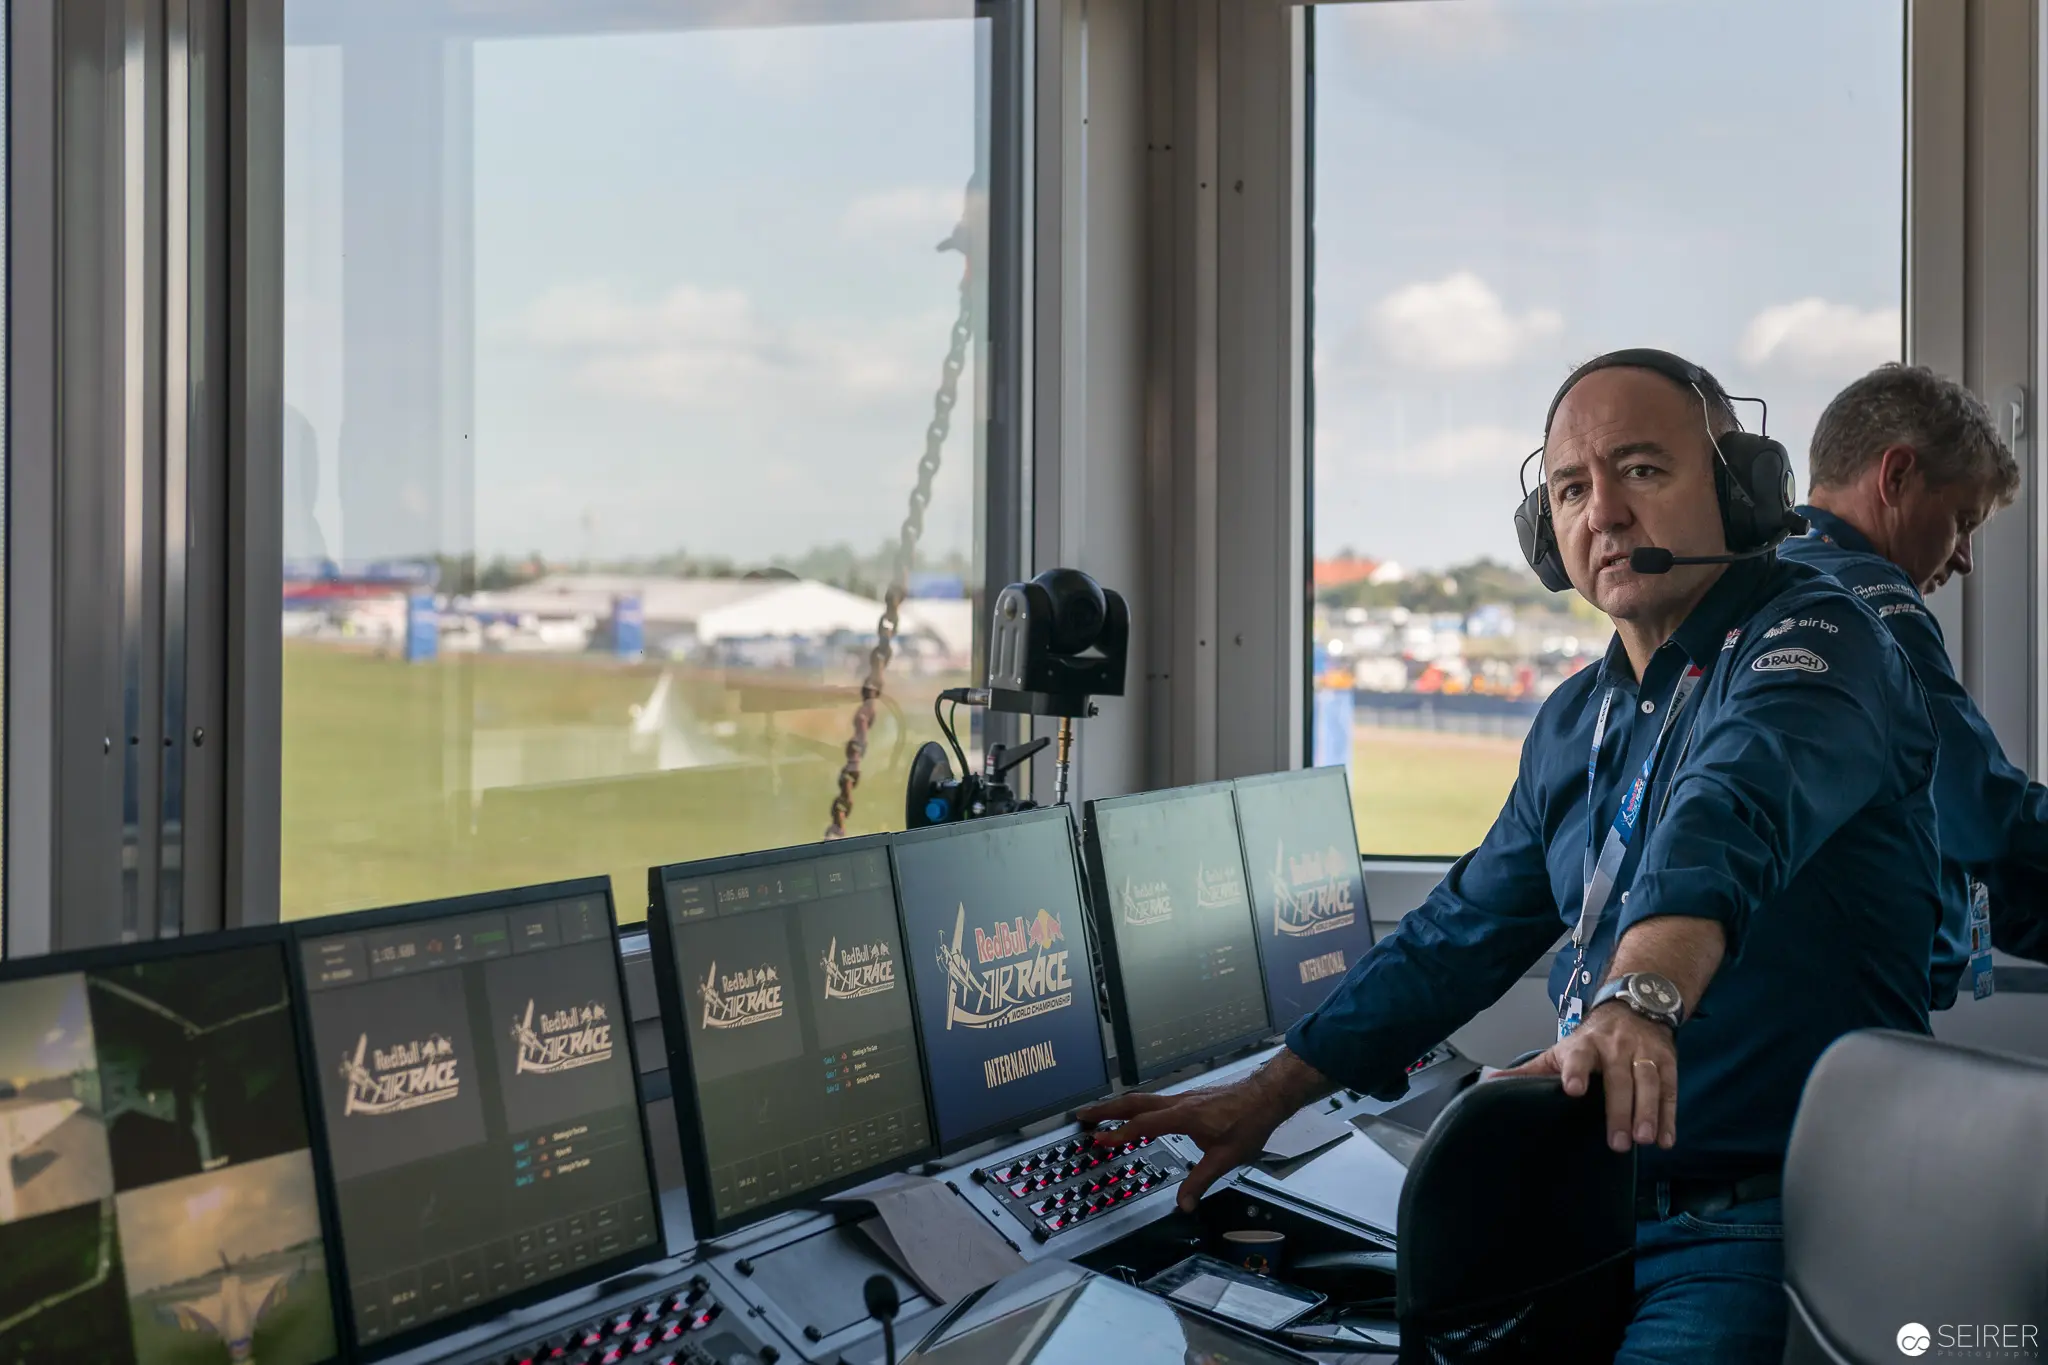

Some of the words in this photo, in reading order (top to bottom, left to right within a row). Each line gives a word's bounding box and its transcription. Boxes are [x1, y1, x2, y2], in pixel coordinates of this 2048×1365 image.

[1772, 654, 1818, 668] RAUCH
[974, 922, 1003, 964] Red
[1000, 916, 1028, 958] Bull
[862, 957, 895, 985] RACE
[976, 965, 1024, 1013] AIR
[1013, 946, 1073, 998] RACE
[746, 982, 783, 1013] RACE
[1011, 1006, 1031, 1020] WORLD
[1032, 994, 1070, 1014] CHAMPIONSHIP
[569, 1022, 612, 1056] RACE
[408, 1058, 459, 1095] RACE
[984, 1040, 1057, 1089] INTERNATIONAL
